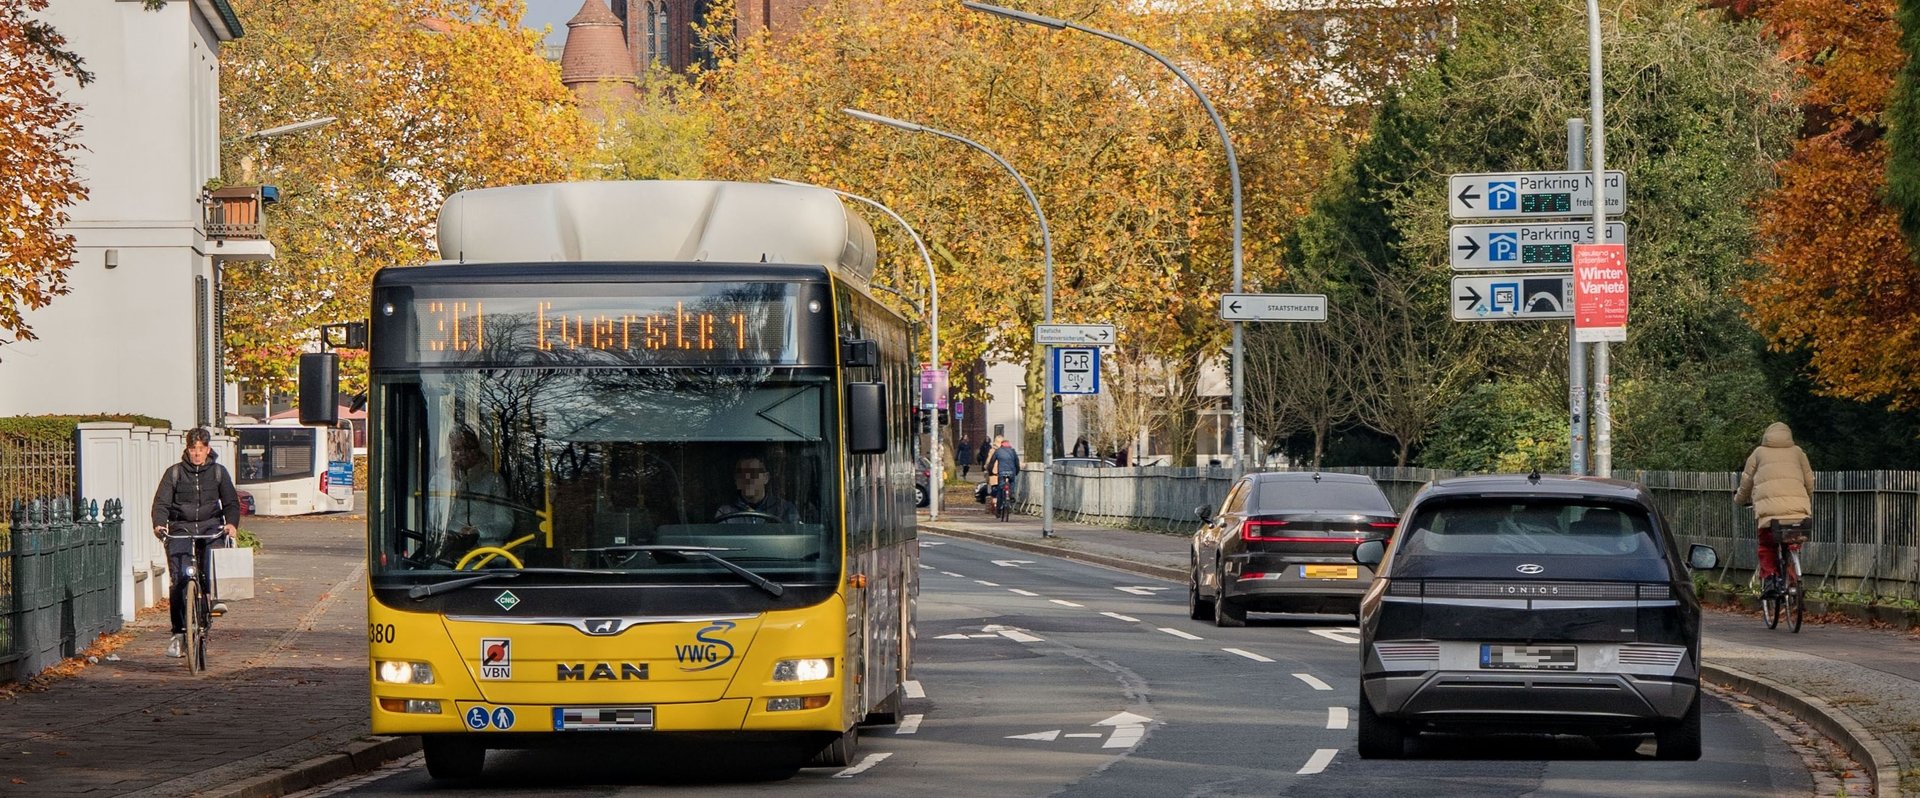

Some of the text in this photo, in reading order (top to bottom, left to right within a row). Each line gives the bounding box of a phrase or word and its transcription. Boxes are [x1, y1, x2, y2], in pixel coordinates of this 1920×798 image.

[1520, 175, 1618, 191] Parkring Nrd
[1522, 194, 1569, 212] 976
[1521, 226, 1613, 242] Parkring Sd
[1579, 267, 1623, 280] Winter
[1580, 281, 1625, 294] Varieté
[1064, 355, 1089, 369] P+R
[1068, 373, 1084, 383] City
[674, 644, 717, 663] VWG
[483, 667, 511, 678] VBN
[556, 662, 650, 681] MAN
